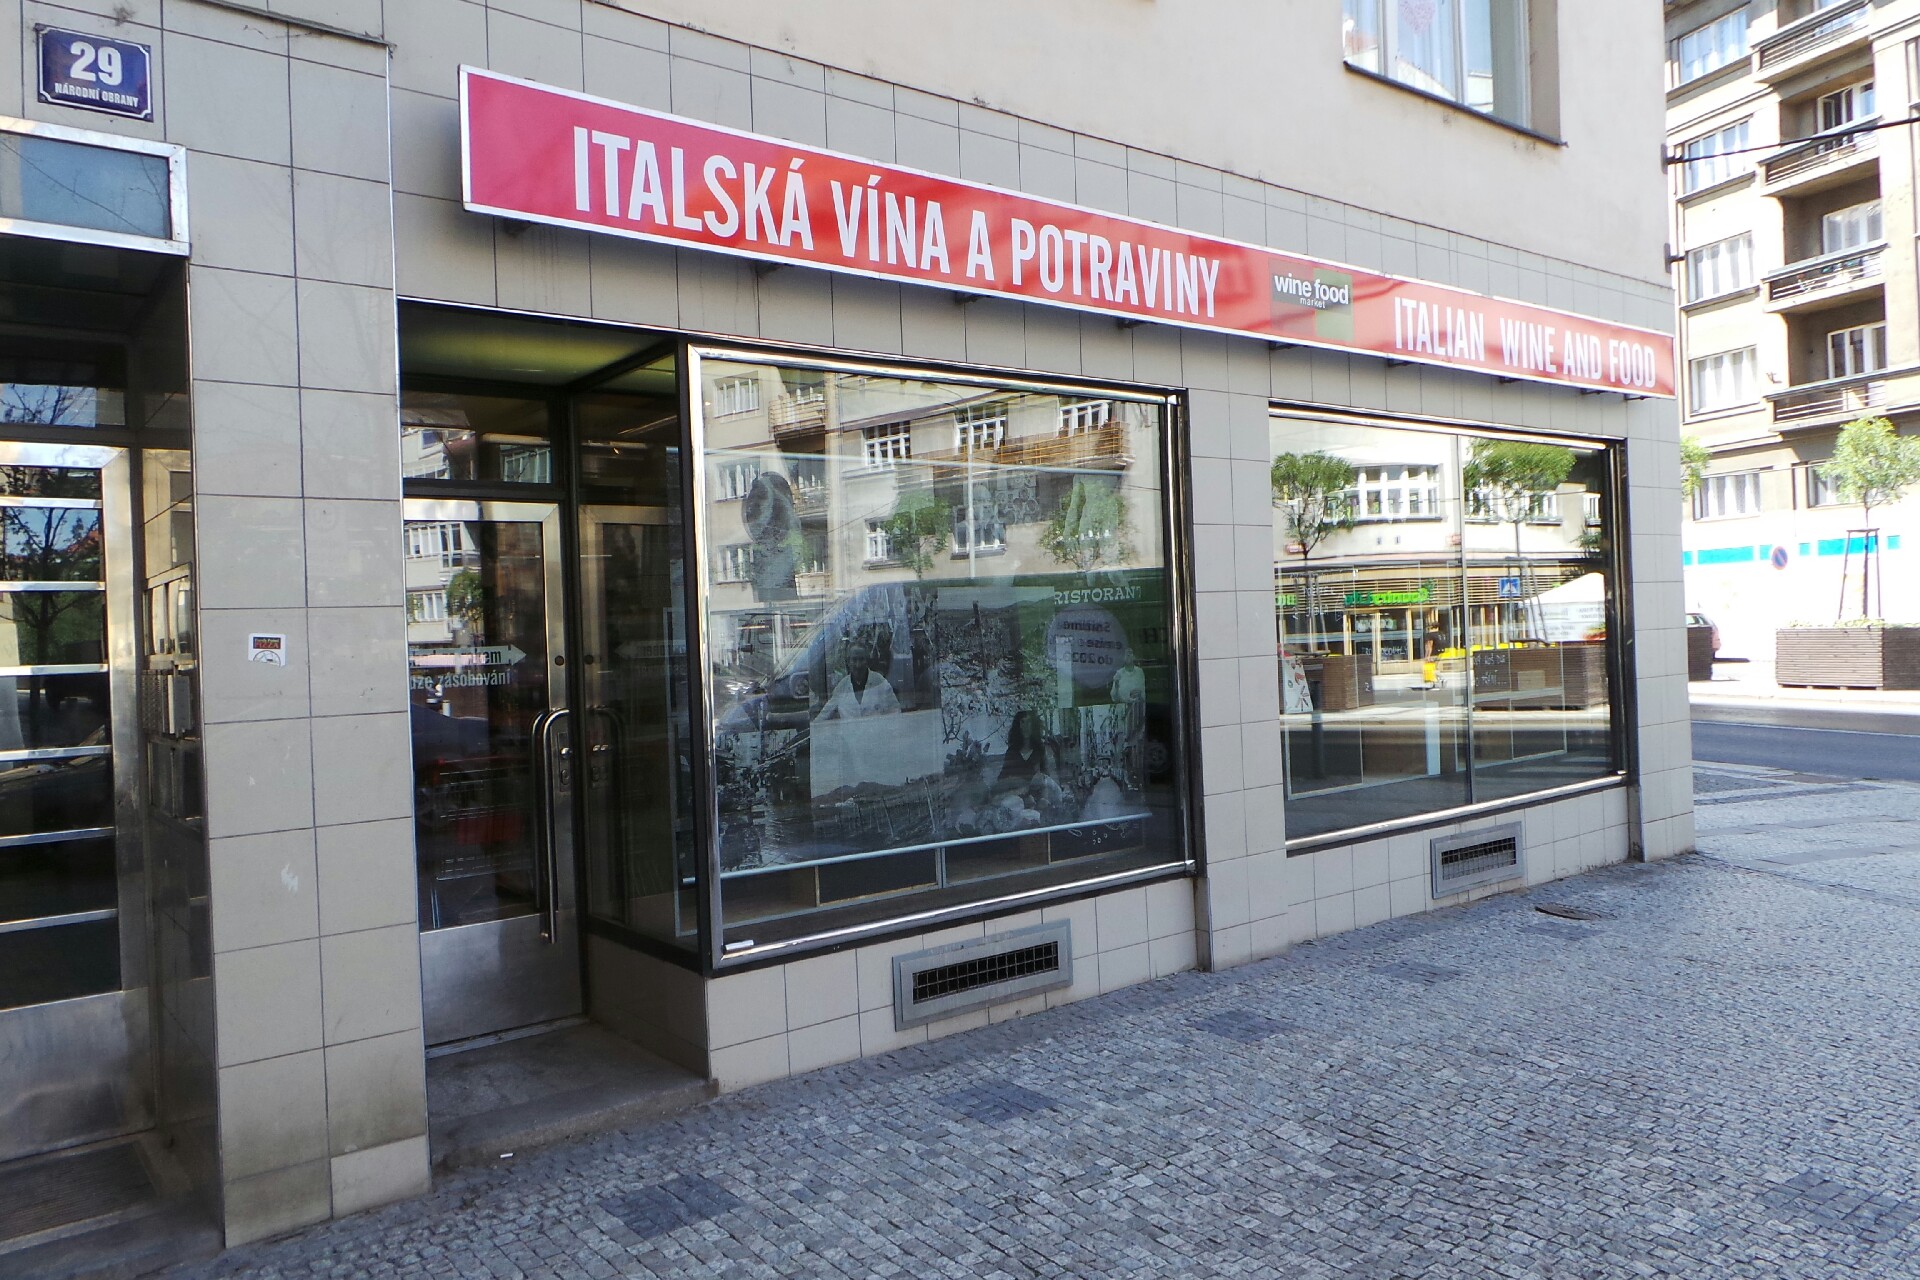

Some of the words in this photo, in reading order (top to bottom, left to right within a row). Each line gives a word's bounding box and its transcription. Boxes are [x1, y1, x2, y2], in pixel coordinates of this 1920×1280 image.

[70, 41, 123, 86] 29
[55, 83, 100, 101] NÁRODNÍ
[102, 91, 139, 107] OBRANY
[573, 126, 814, 251] ITALSKÁ
[830, 174, 951, 274] VÍNA
[966, 209, 995, 281] A
[1010, 217, 1220, 318] POTRAVINY
[1274, 272, 1312, 298] wine
[1313, 279, 1349, 305] food
[1300, 297, 1326, 309] market
[1394, 296, 1485, 362] ITALIAN
[1500, 317, 1556, 373] WINE
[1562, 330, 1602, 380] AND
[1608, 339, 1656, 388] FOOD
[438, 668, 511, 688] zásobování
